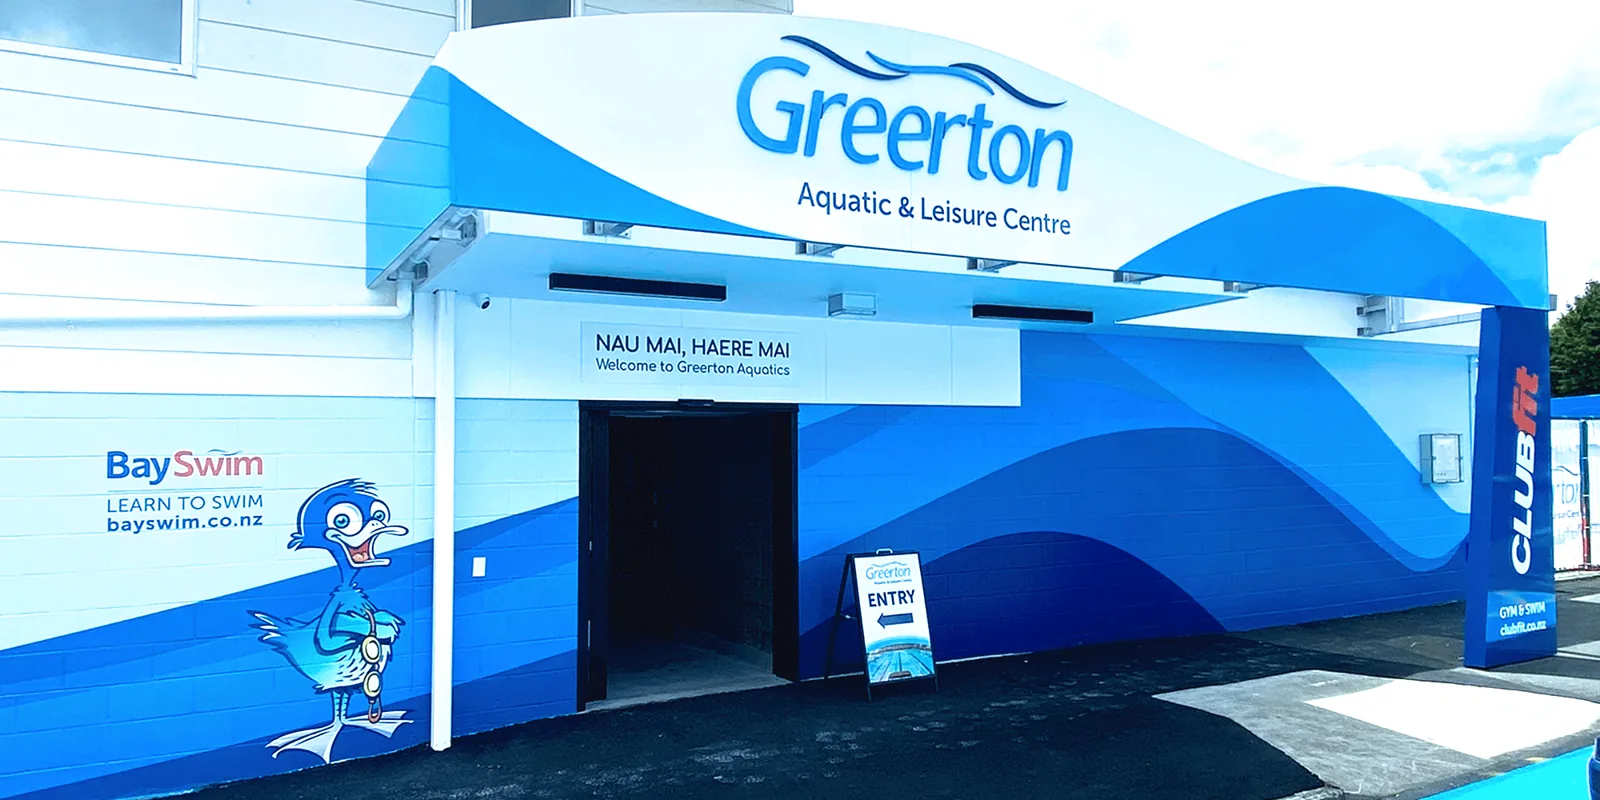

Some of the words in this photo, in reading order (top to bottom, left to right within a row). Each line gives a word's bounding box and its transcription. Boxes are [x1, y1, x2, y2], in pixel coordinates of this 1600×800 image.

[736, 55, 1074, 191] Greerton
[797, 182, 892, 216] Aquatic
[898, 197, 915, 218] &
[921, 197, 998, 228] Leisure
[1003, 208, 1072, 235] Centre
[596, 334, 640, 353] NAU
[646, 336, 686, 358] MAI,
[692, 338, 753, 357] HAERE
[758, 341, 790, 358] MAI
[595, 357, 656, 372] Welcome
[660, 360, 674, 373] to
[677, 360, 734, 374] Greerton
[737, 363, 790, 377] Aquatics
[107, 497, 172, 513] LEARN
[177, 496, 206, 510] TO
[212, 494, 264, 509] SWIM
[107, 515, 264, 534] bayswim.co.nz
[866, 567, 911, 579] Greerton
[868, 589, 916, 608] ENTRY
[1499, 605, 1518, 619] GYM
[1525, 601, 1546, 615] SWIM
